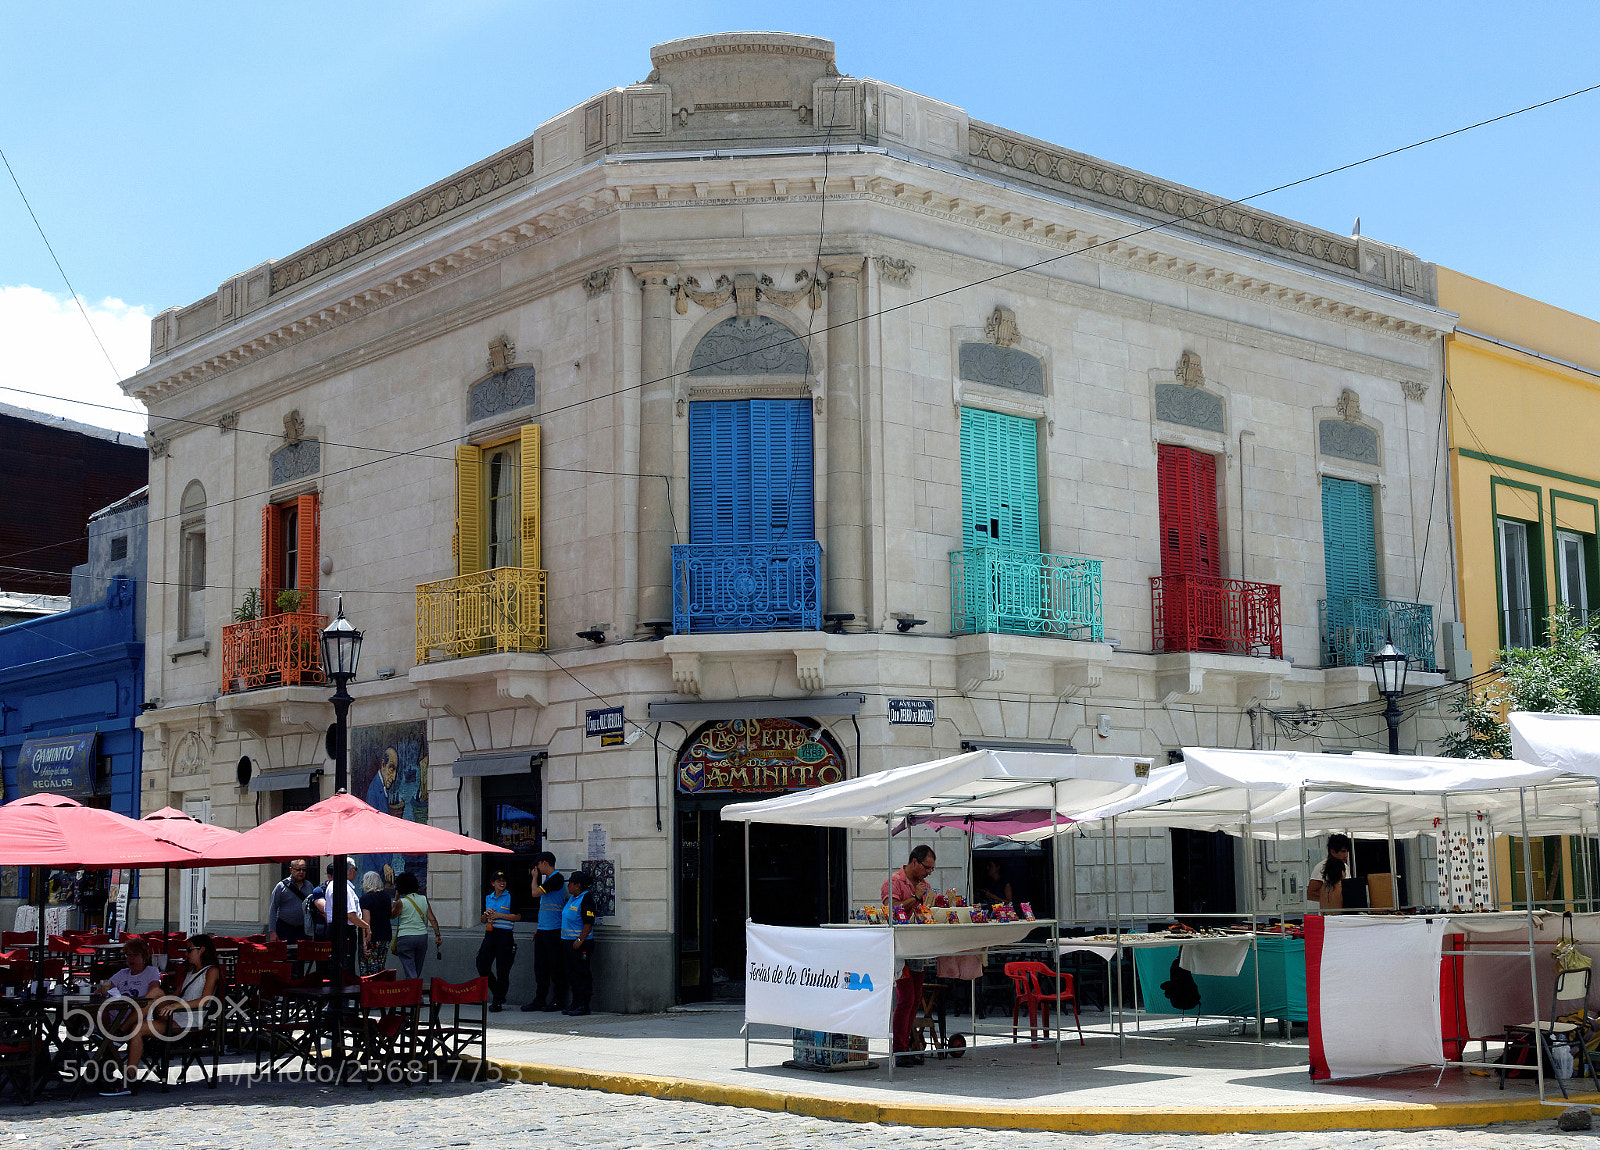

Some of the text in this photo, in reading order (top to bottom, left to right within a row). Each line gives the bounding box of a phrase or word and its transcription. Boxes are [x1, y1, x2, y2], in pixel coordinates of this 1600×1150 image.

[724, 719, 813, 750] PERLA
[32, 745, 75, 774] CAMINITO
[746, 758, 767, 767] DE
[32, 778, 73, 789] REGALOS
[680, 762, 842, 791] CAMINITO
[771, 965, 783, 984] de
[785, 965, 797, 985] la
[800, 967, 840, 989] Ciudad
[848, 972, 874, 992] BA
